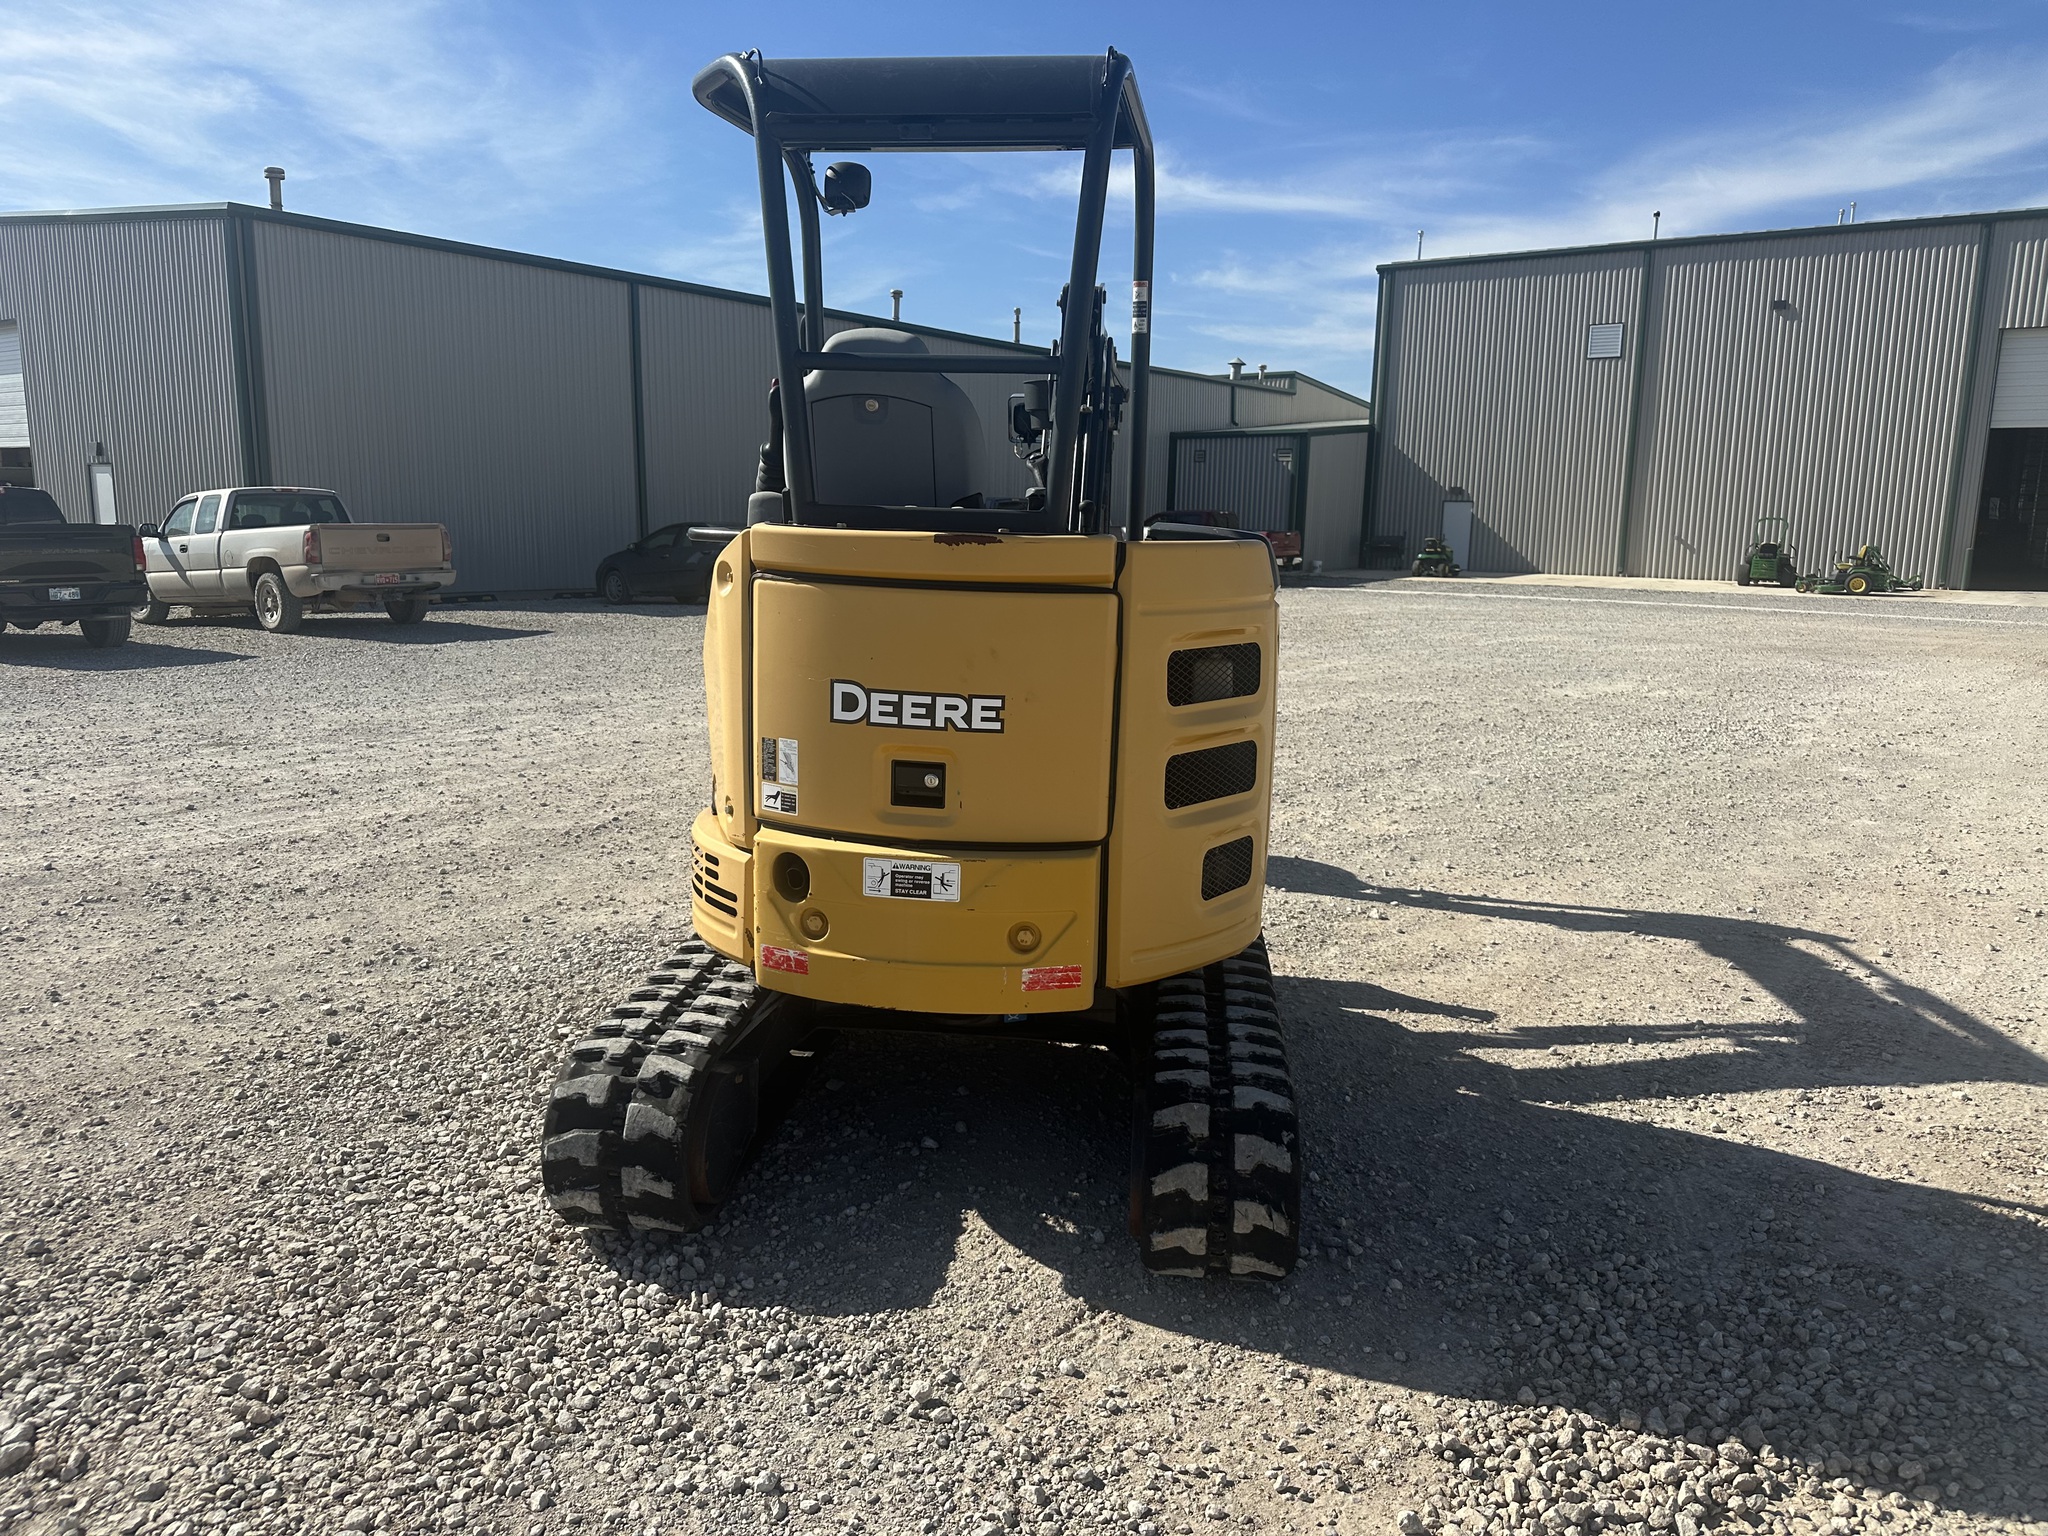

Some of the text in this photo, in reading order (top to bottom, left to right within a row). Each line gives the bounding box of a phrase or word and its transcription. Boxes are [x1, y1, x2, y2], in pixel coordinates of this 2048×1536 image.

[329, 546, 437, 555] CHEVROLET
[833, 682, 1002, 730] DEERE
[899, 863, 931, 871] WARNING
